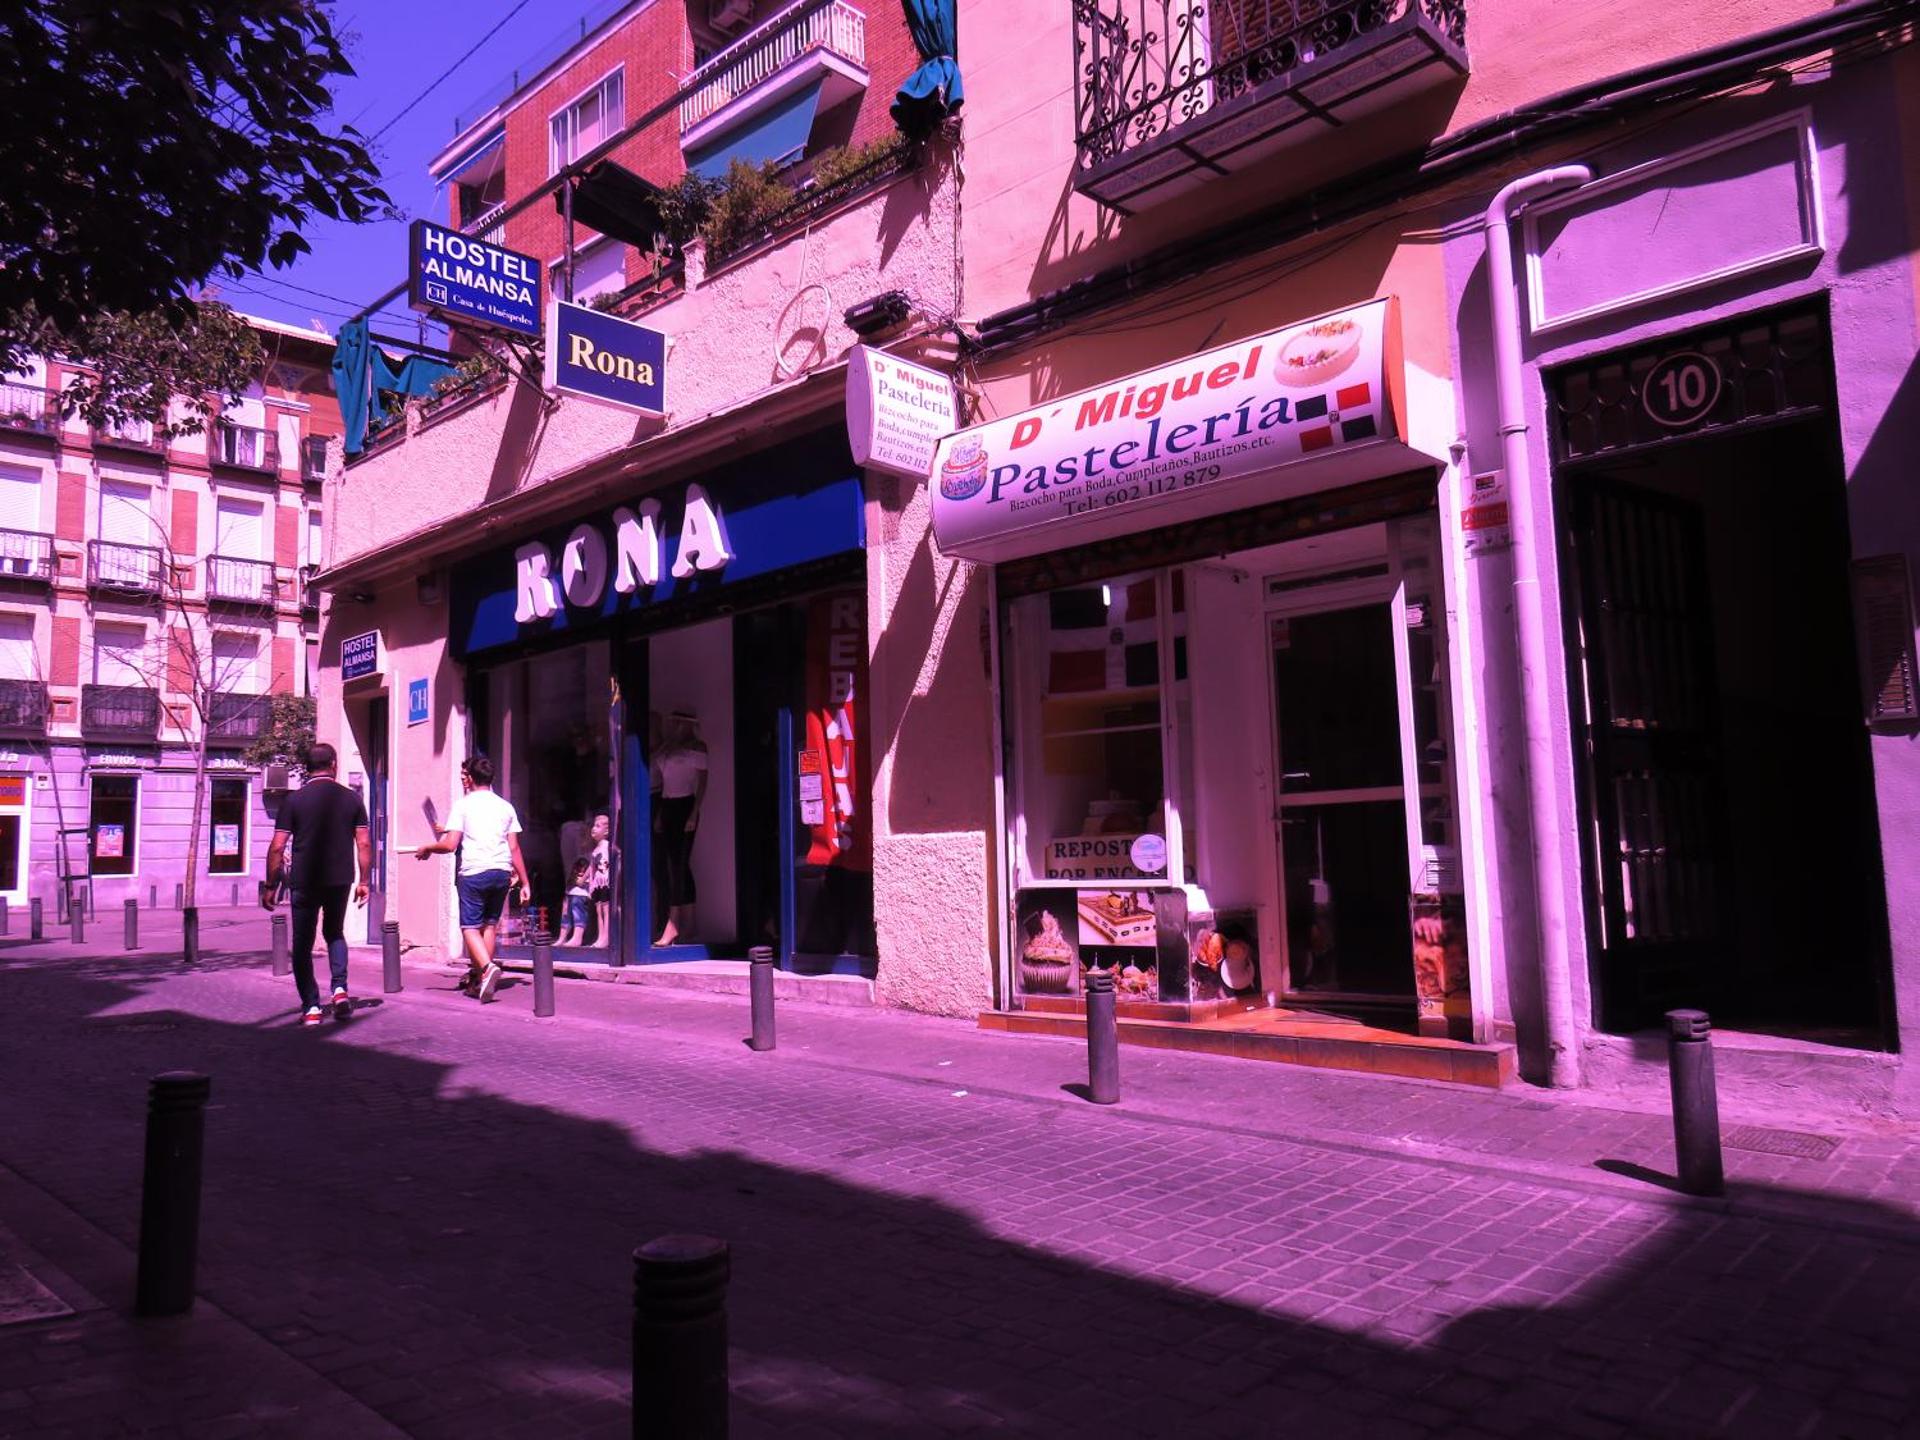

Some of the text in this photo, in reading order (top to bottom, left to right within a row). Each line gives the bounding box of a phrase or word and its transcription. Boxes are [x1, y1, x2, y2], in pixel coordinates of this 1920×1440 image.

[425, 227, 536, 285] HOSTEL
[425, 258, 533, 307] ALMANSA
[453, 294, 474, 308] Casa
[477, 302, 487, 312] de
[567, 333, 655, 387] Rona
[896, 368, 948, 396] Miguel
[1074, 345, 1263, 431] Miguel
[1660, 364, 1706, 411] 10
[919, 418, 939, 431] para
[895, 452, 913, 465] 602
[986, 395, 1294, 504] Pastelería
[1009, 492, 1056, 513] Bizcocho
[1058, 486, 1082, 502] para
[1105, 486, 1141, 507] 602
[1149, 476, 1177, 496] 112
[1183, 464, 1221, 487] 879
[514, 482, 733, 623] RONA
[344, 635, 376, 655] HOSTEL
[344, 650, 375, 668] ALMANSA
[1055, 839, 1134, 859] REPOST
